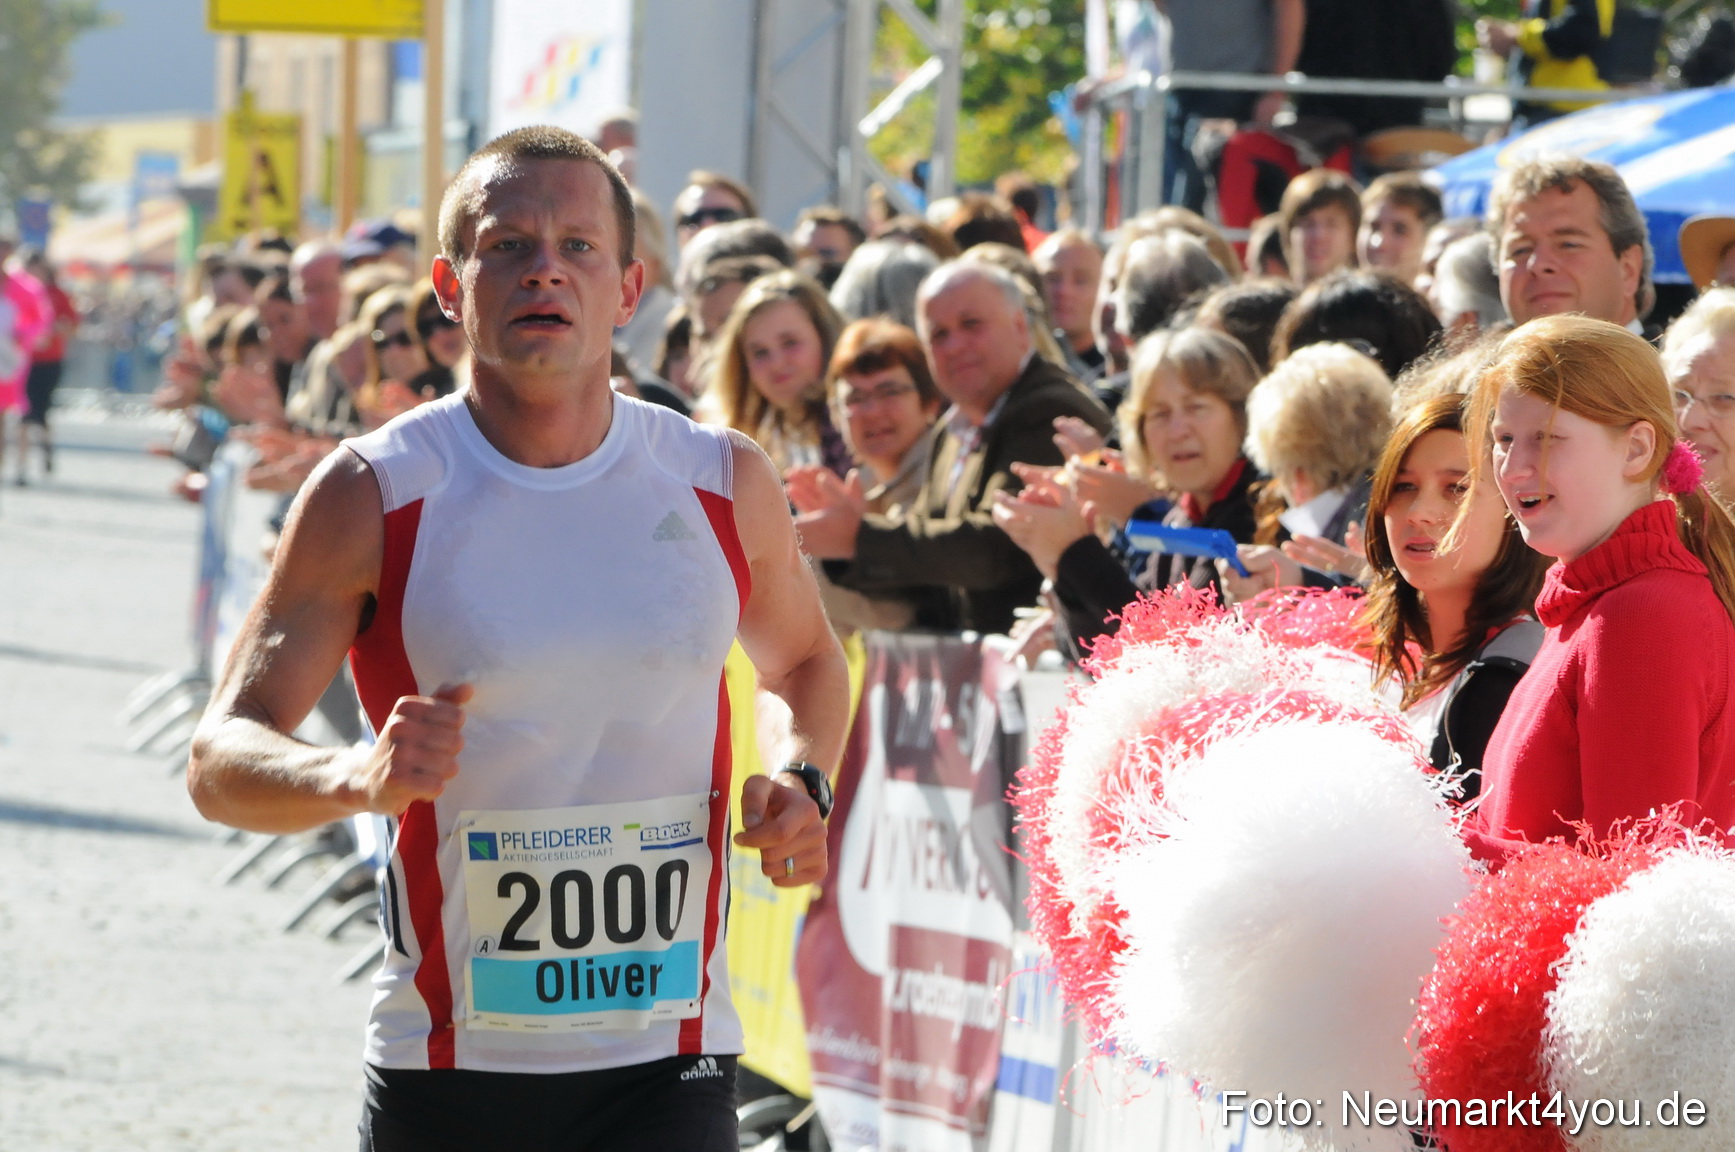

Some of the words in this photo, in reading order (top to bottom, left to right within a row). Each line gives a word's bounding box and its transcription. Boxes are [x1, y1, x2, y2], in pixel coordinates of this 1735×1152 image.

[501, 826, 613, 850] PFLEIDERER
[640, 821, 692, 842] BOCK
[503, 847, 614, 863] AKTIENGESELLSCHAFT
[497, 859, 689, 951] 2000
[535, 957, 663, 1004] Oliver
